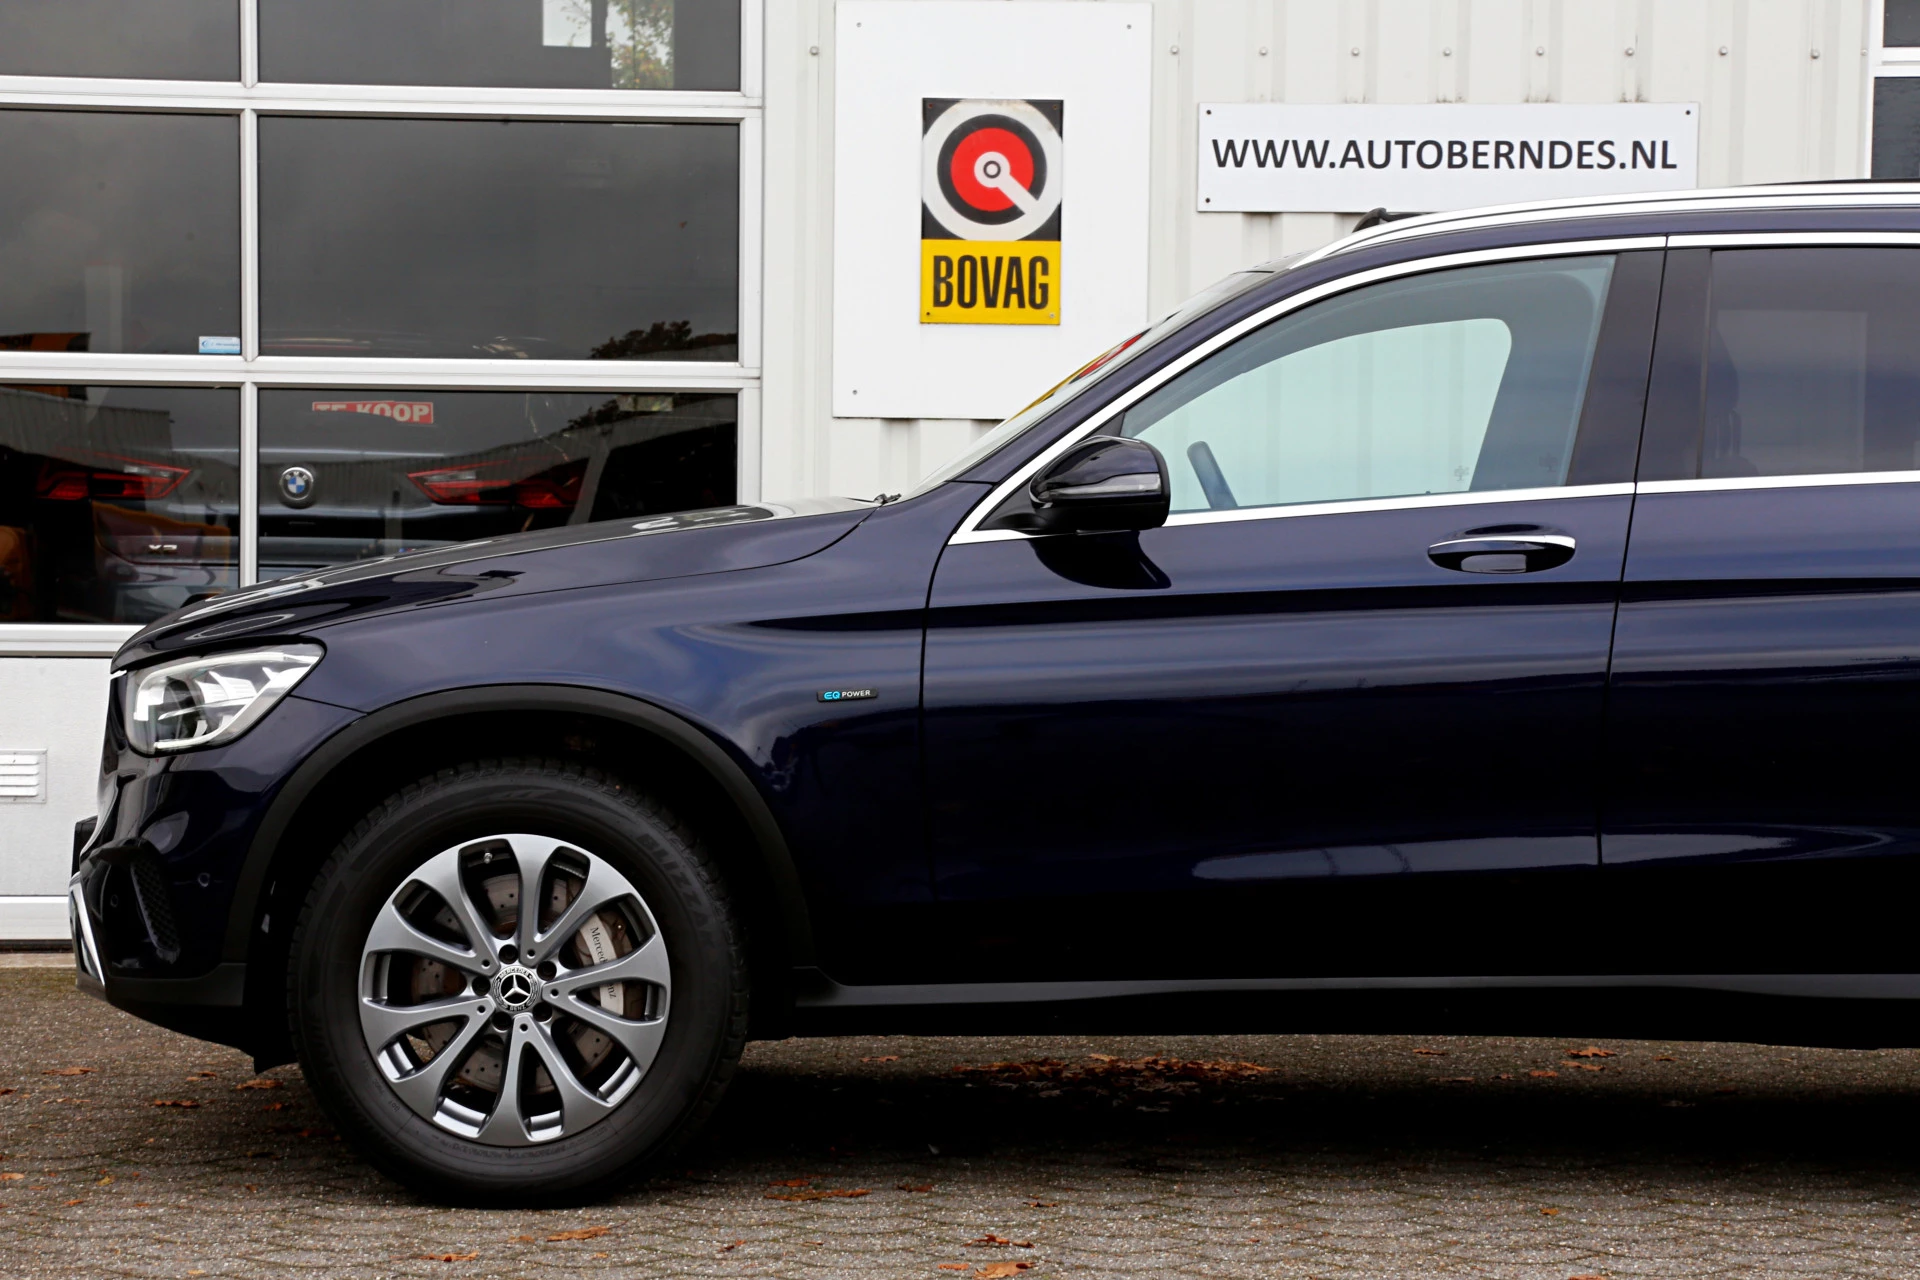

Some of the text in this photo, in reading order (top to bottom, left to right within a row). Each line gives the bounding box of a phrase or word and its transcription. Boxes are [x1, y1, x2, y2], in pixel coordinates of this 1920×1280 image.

[1212, 139, 1677, 169] WWW.AUTOBERNDES.NL
[933, 255, 1049, 310] BOVAG
[823, 689, 871, 700] EQ POWER
